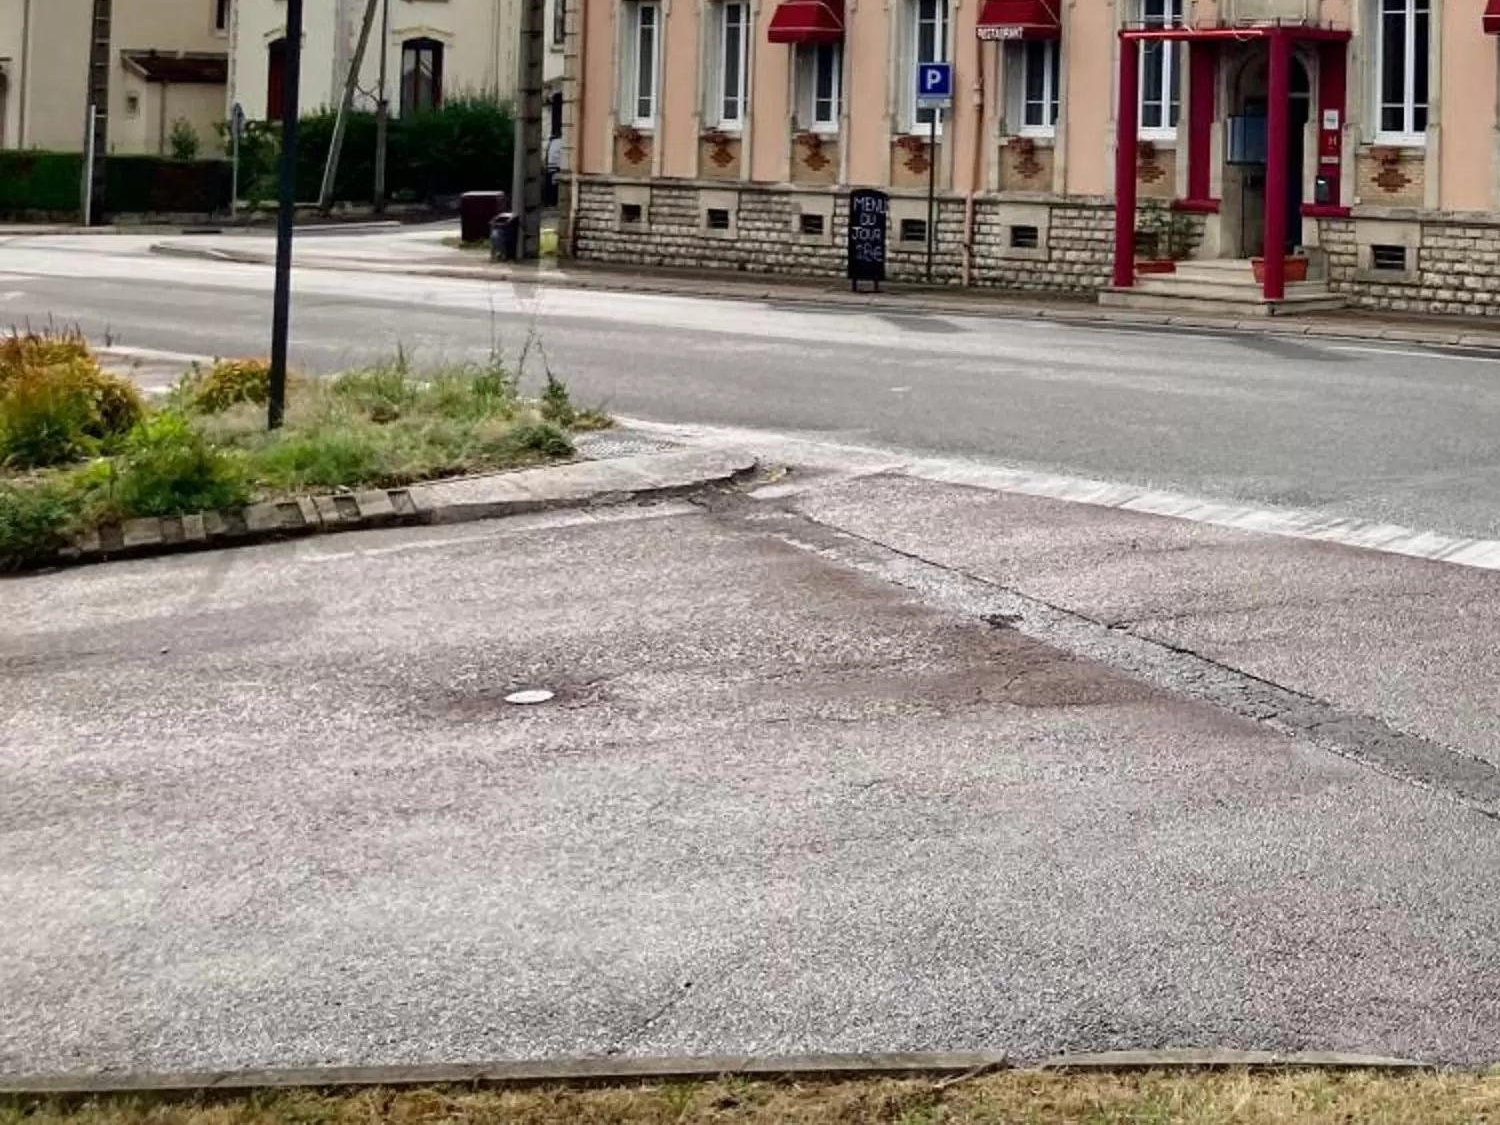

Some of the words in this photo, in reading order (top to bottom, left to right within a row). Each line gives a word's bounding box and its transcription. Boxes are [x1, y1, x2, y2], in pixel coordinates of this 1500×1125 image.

[927, 69, 941, 90] P
[853, 196, 888, 214] MENU
[860, 213, 877, 226] DU
[851, 226, 881, 241] JOUR
